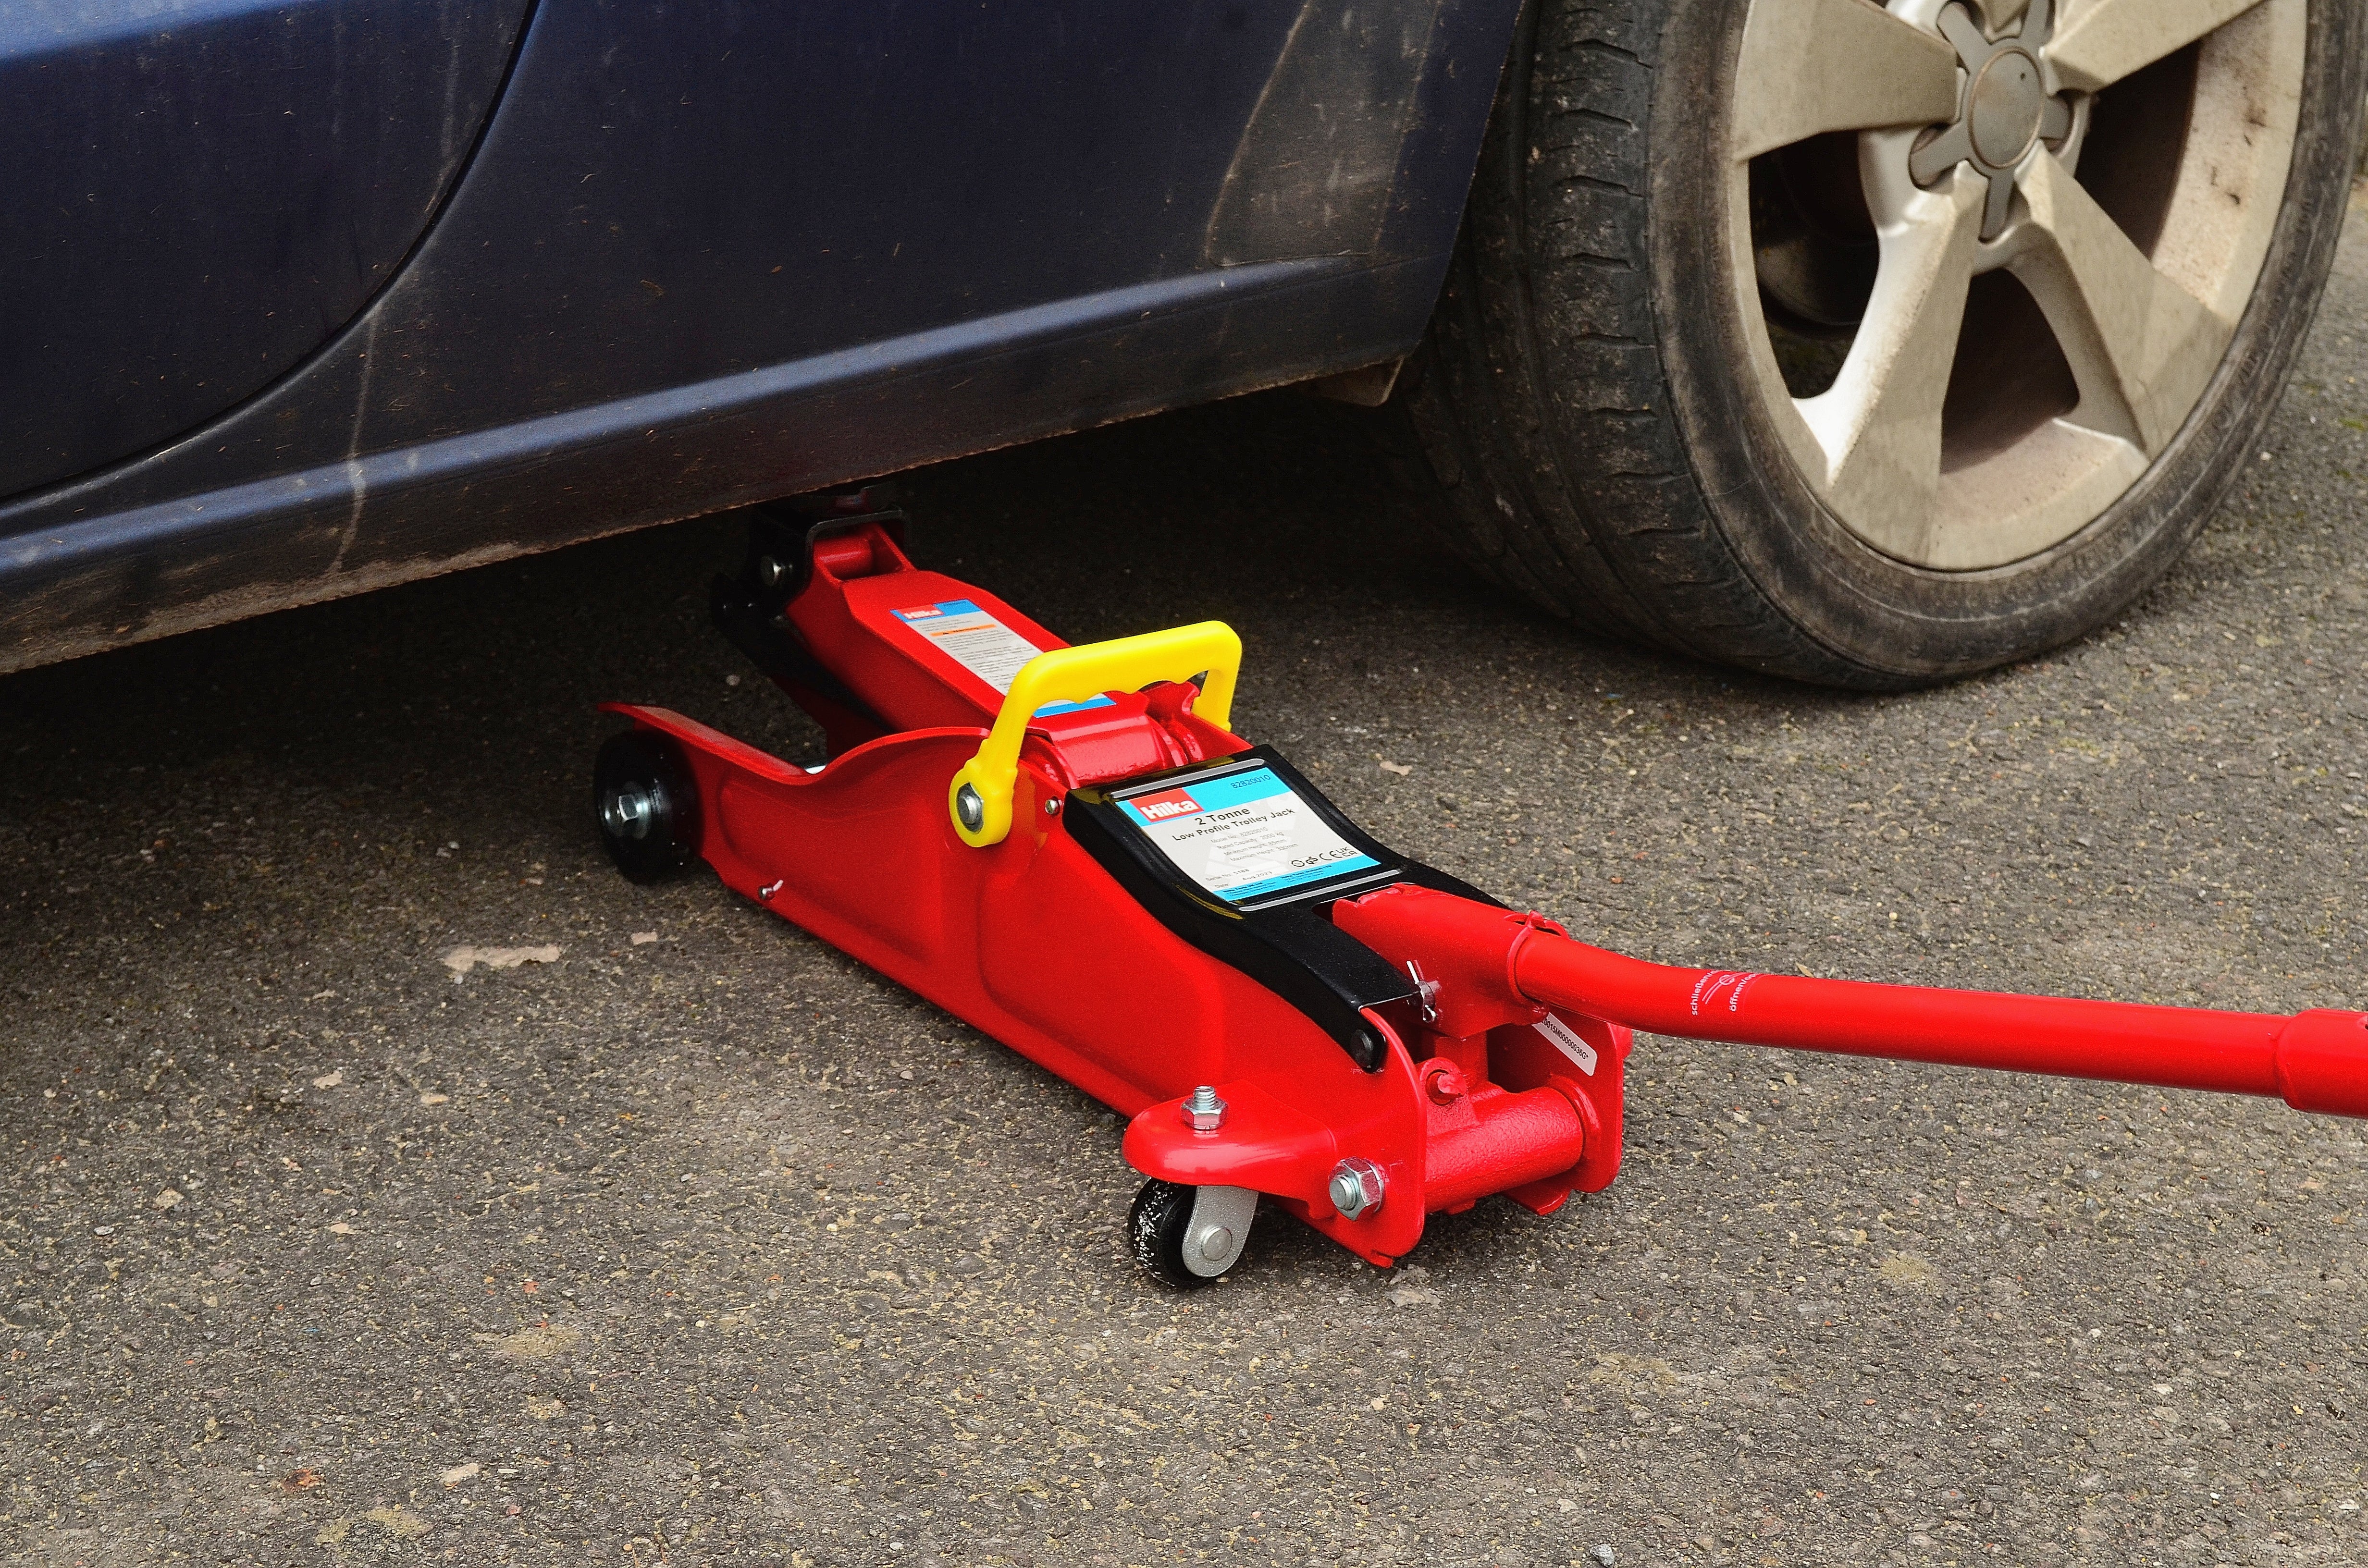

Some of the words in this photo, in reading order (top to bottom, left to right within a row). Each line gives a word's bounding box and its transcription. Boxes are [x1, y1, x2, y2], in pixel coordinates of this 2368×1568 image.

[1230, 774, 1271, 789] 82820010
[1139, 799, 1199, 820] Hilka
[1194, 817, 1207, 825] 2
[1205, 808, 1250, 822] Tonne
[1172, 832, 1195, 841] Low
[1195, 824, 1231, 836] Profile
[1230, 815, 1268, 827] Trolley
[1270, 808, 1295, 818] Jack
